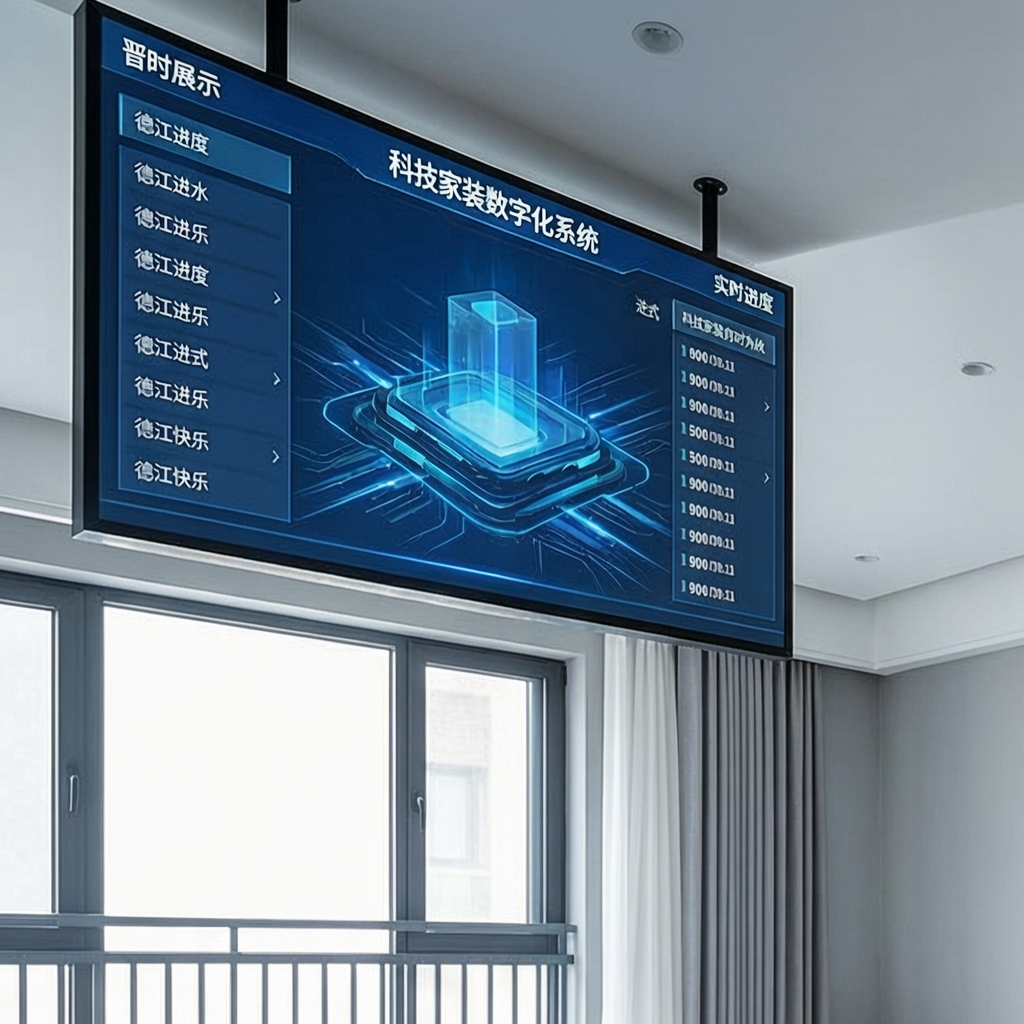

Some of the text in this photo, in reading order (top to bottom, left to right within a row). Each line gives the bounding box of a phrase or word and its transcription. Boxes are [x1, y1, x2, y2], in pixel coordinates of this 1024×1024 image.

[122, 37, 221, 99] 晋时展示
[389, 149, 599, 255] 科技家装数字化系统
